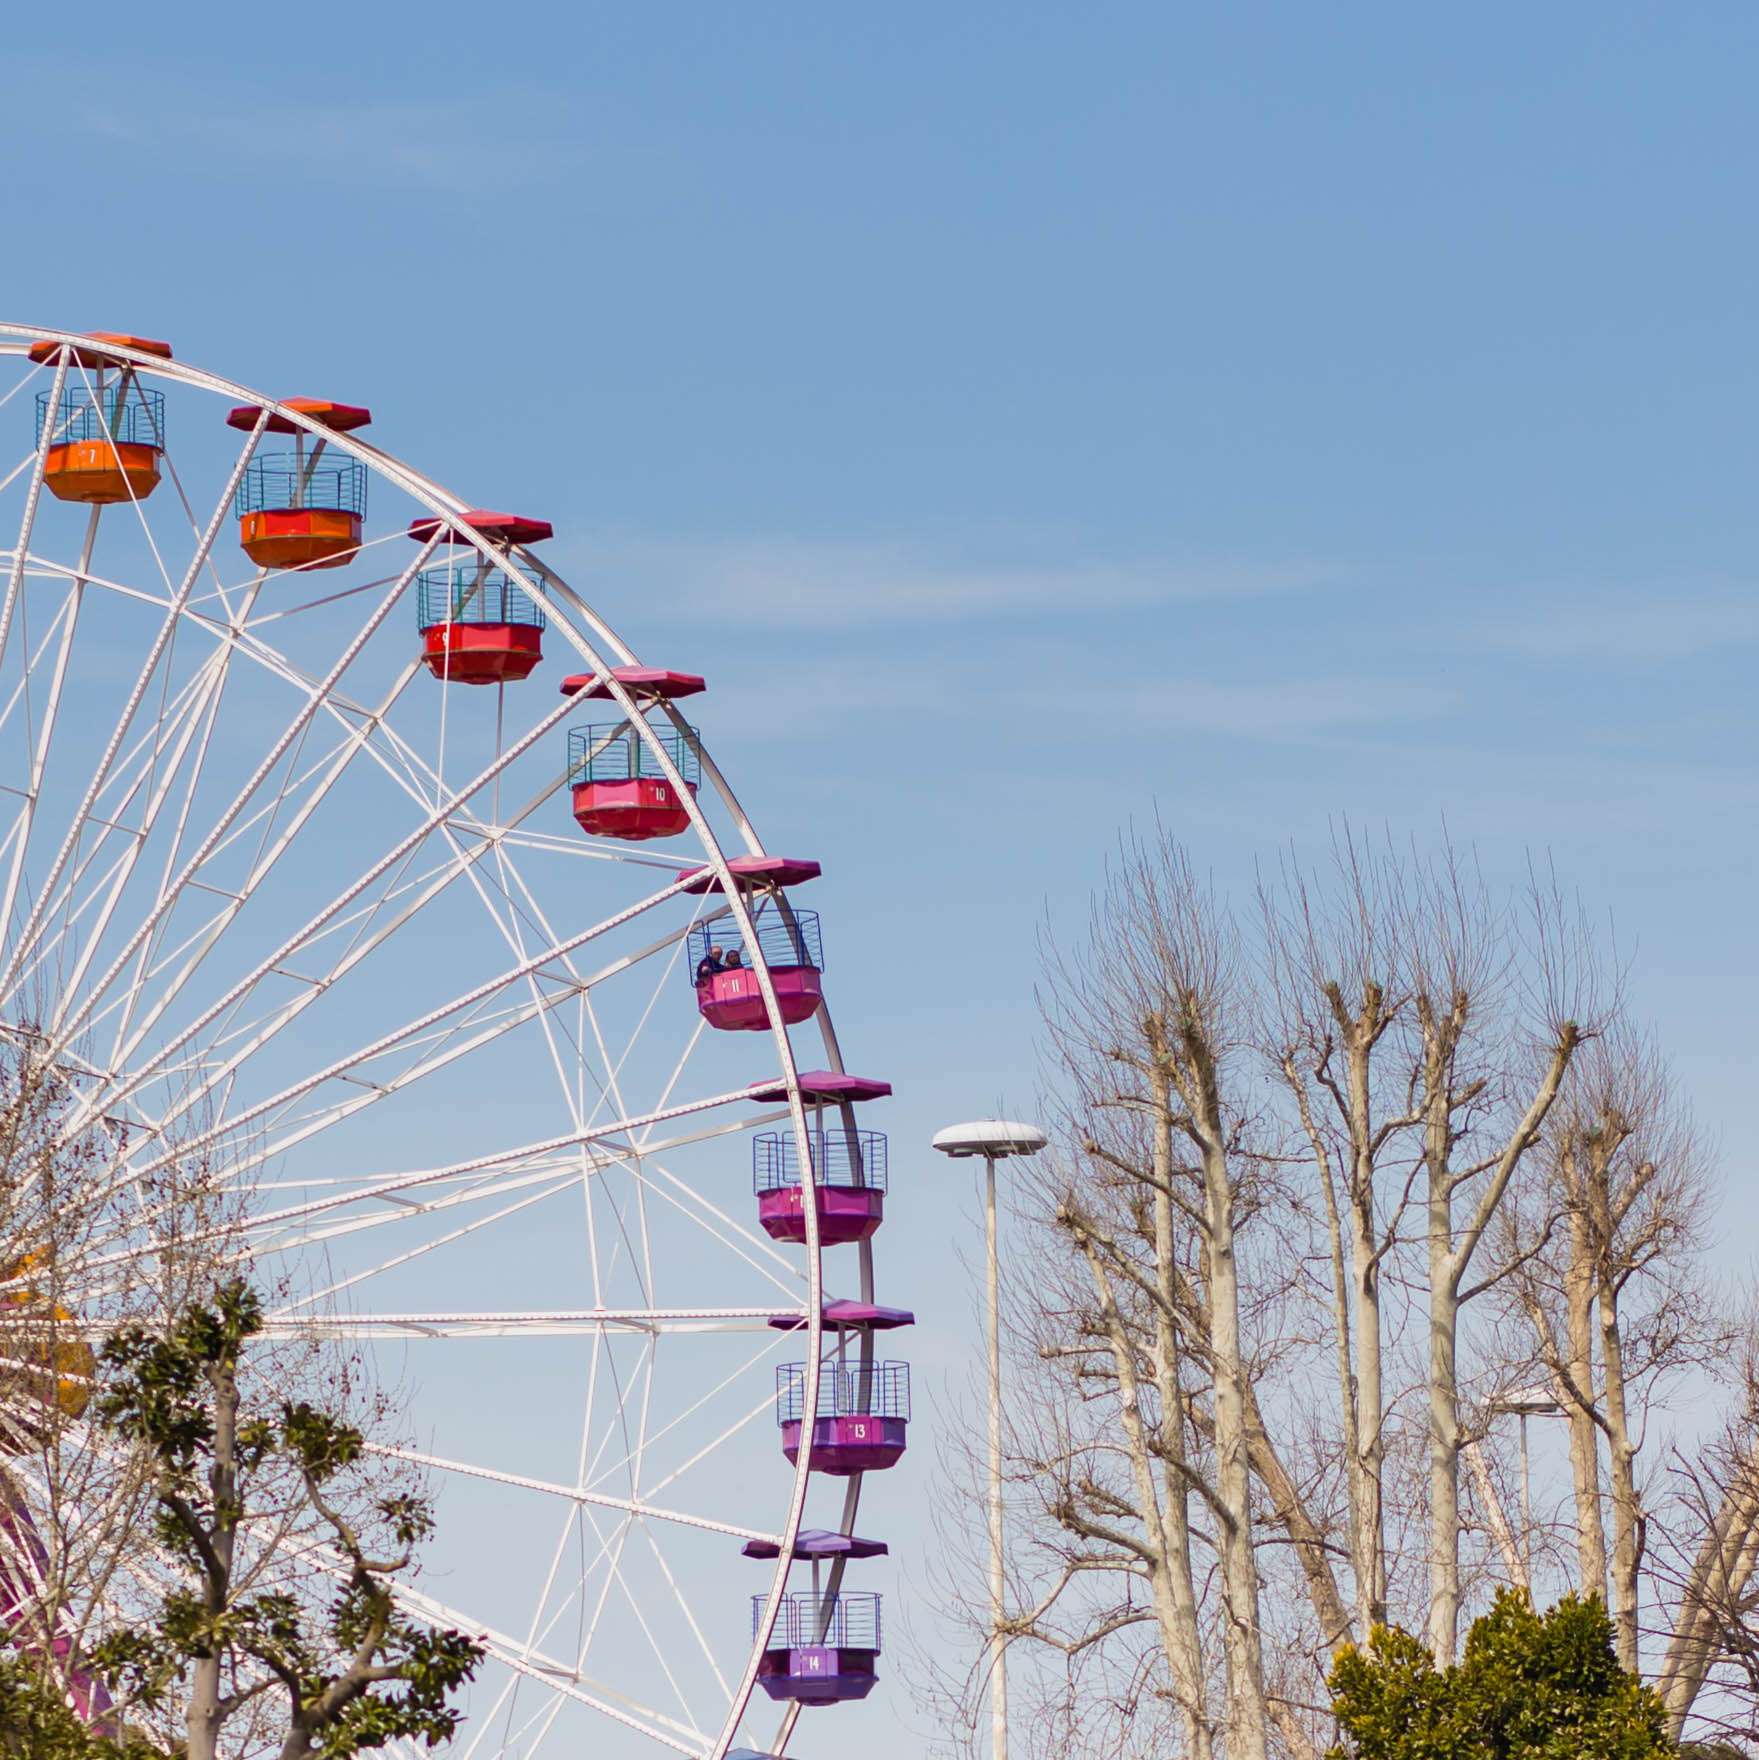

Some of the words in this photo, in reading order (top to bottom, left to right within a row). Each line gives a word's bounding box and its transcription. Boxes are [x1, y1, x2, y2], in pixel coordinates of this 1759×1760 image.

[90, 449, 96, 463] 7
[656, 788, 665, 801] 10
[732, 979, 739, 993] 11
[855, 1424, 866, 1438] 13
[809, 1656, 820, 1670] 14
